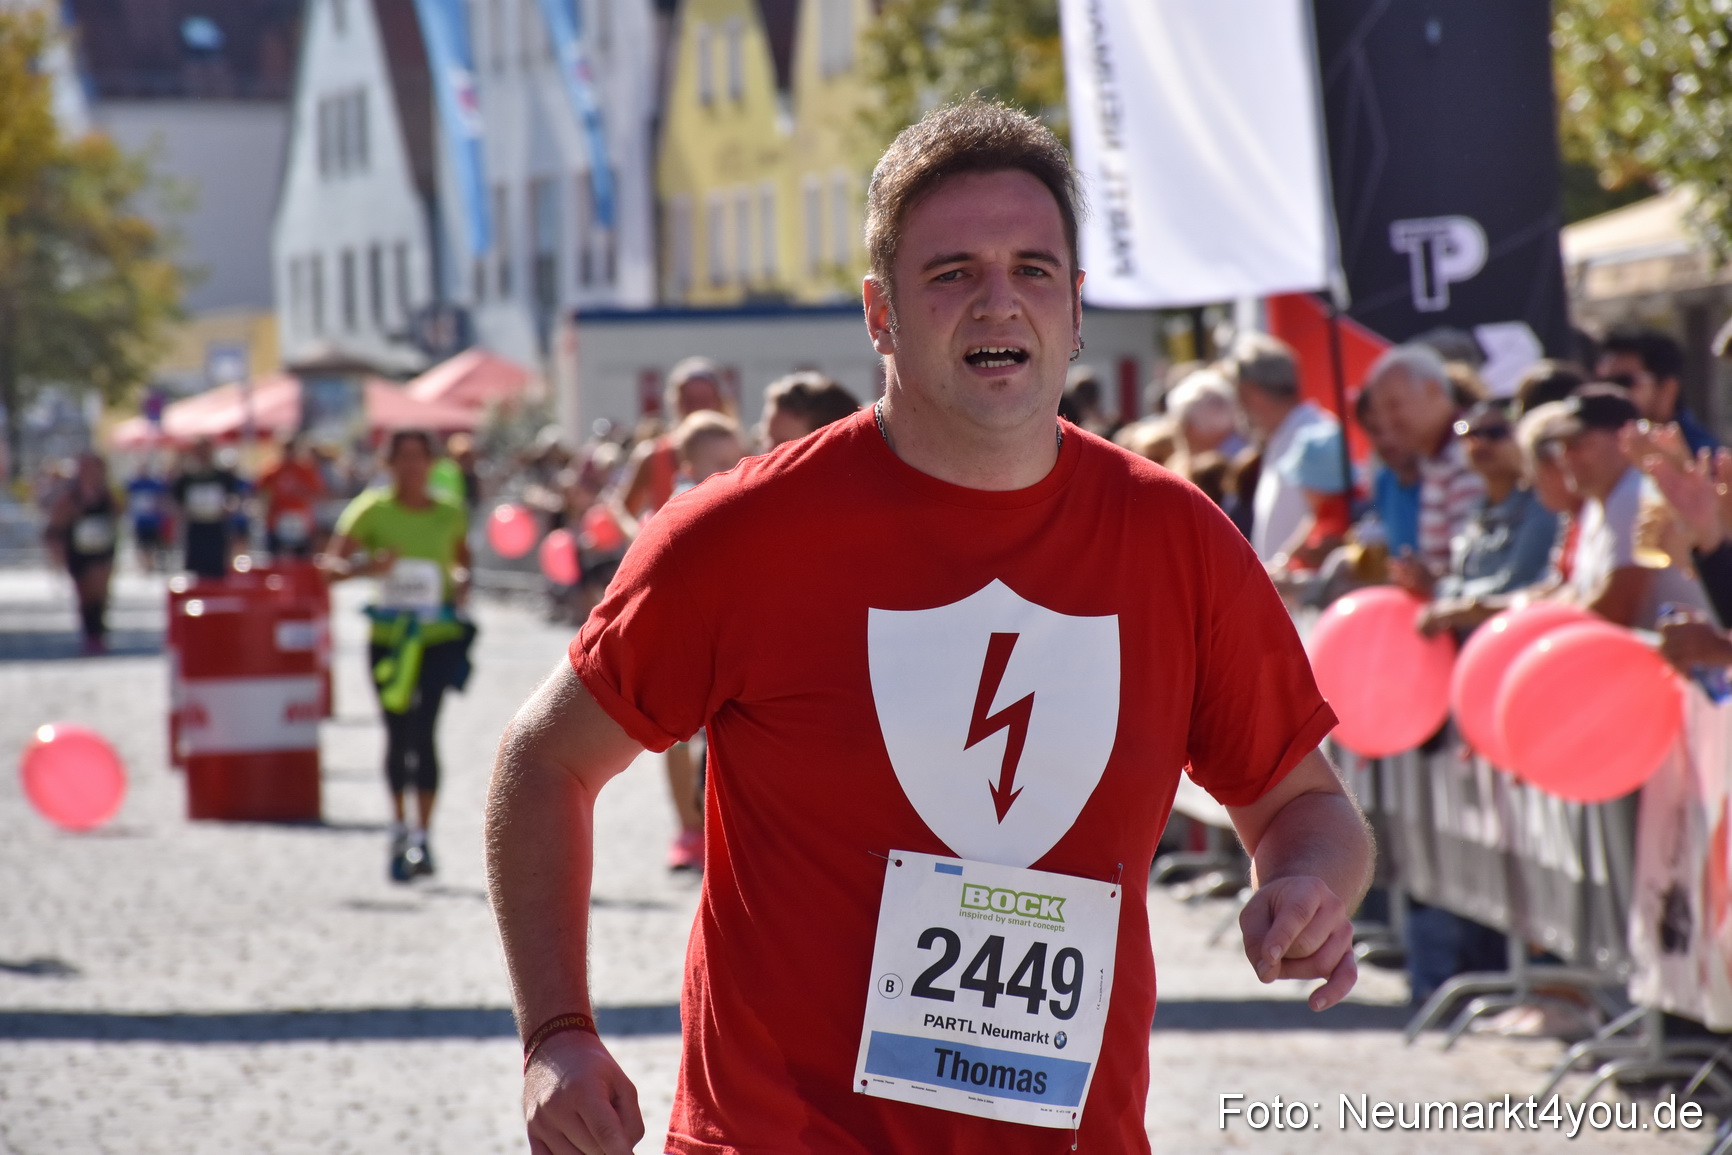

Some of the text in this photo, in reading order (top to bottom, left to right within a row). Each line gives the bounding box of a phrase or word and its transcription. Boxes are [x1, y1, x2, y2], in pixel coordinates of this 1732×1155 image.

[959, 909, 1065, 933] inspired by smart concepts
[961, 883, 1067, 923] BOCK
[885, 979, 895, 993] B
[911, 926, 1084, 1021] 2449
[923, 1013, 977, 1034] PARTL
[981, 1022, 1050, 1045] Neumarkt
[934, 1047, 1048, 1095] Thomas
